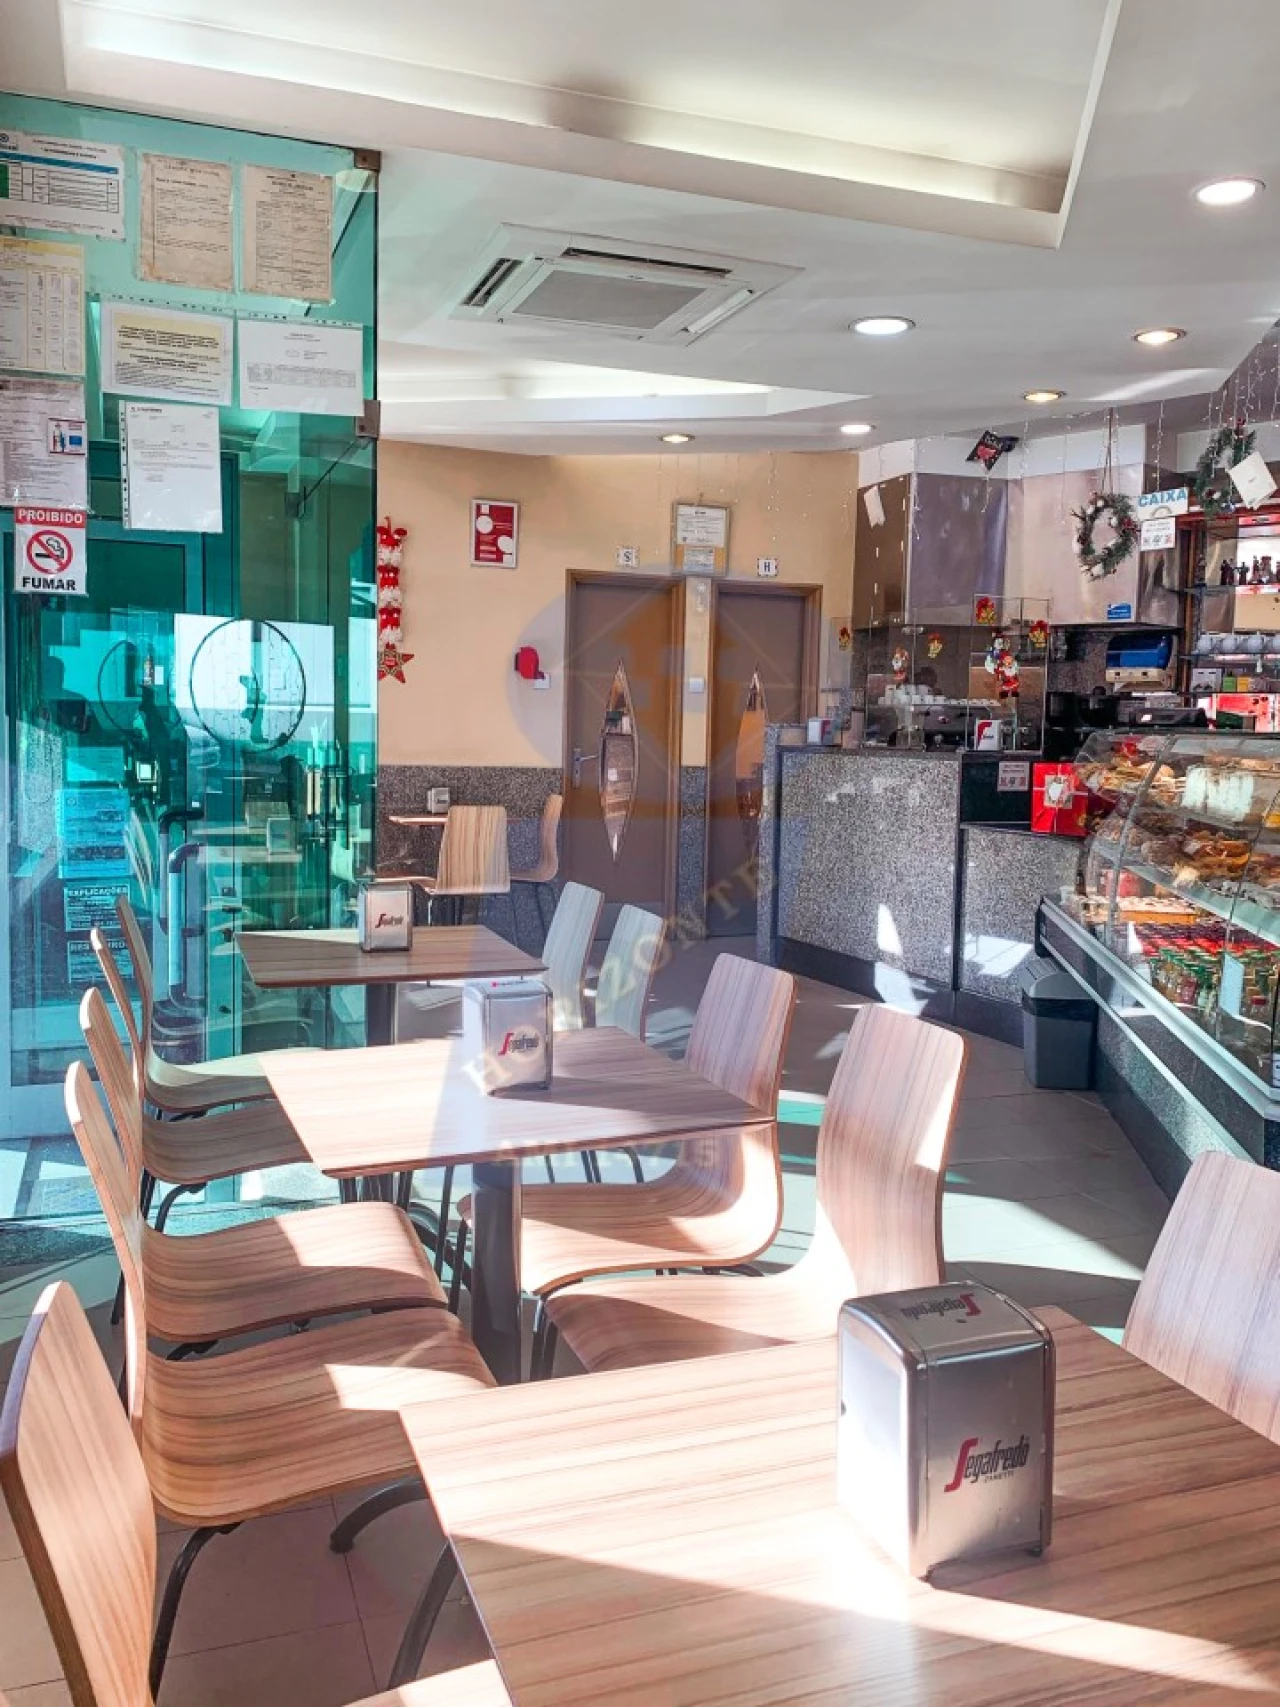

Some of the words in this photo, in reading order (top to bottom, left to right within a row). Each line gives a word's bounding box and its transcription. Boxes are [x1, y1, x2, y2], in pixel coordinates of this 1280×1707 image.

[1138, 488, 1187, 507] CAIXA
[18, 508, 83, 524] PROIBIDO
[763, 561, 771, 572] H
[22, 575, 76, 591] FUMAR
[943, 1434, 1031, 1493] Segafredo
